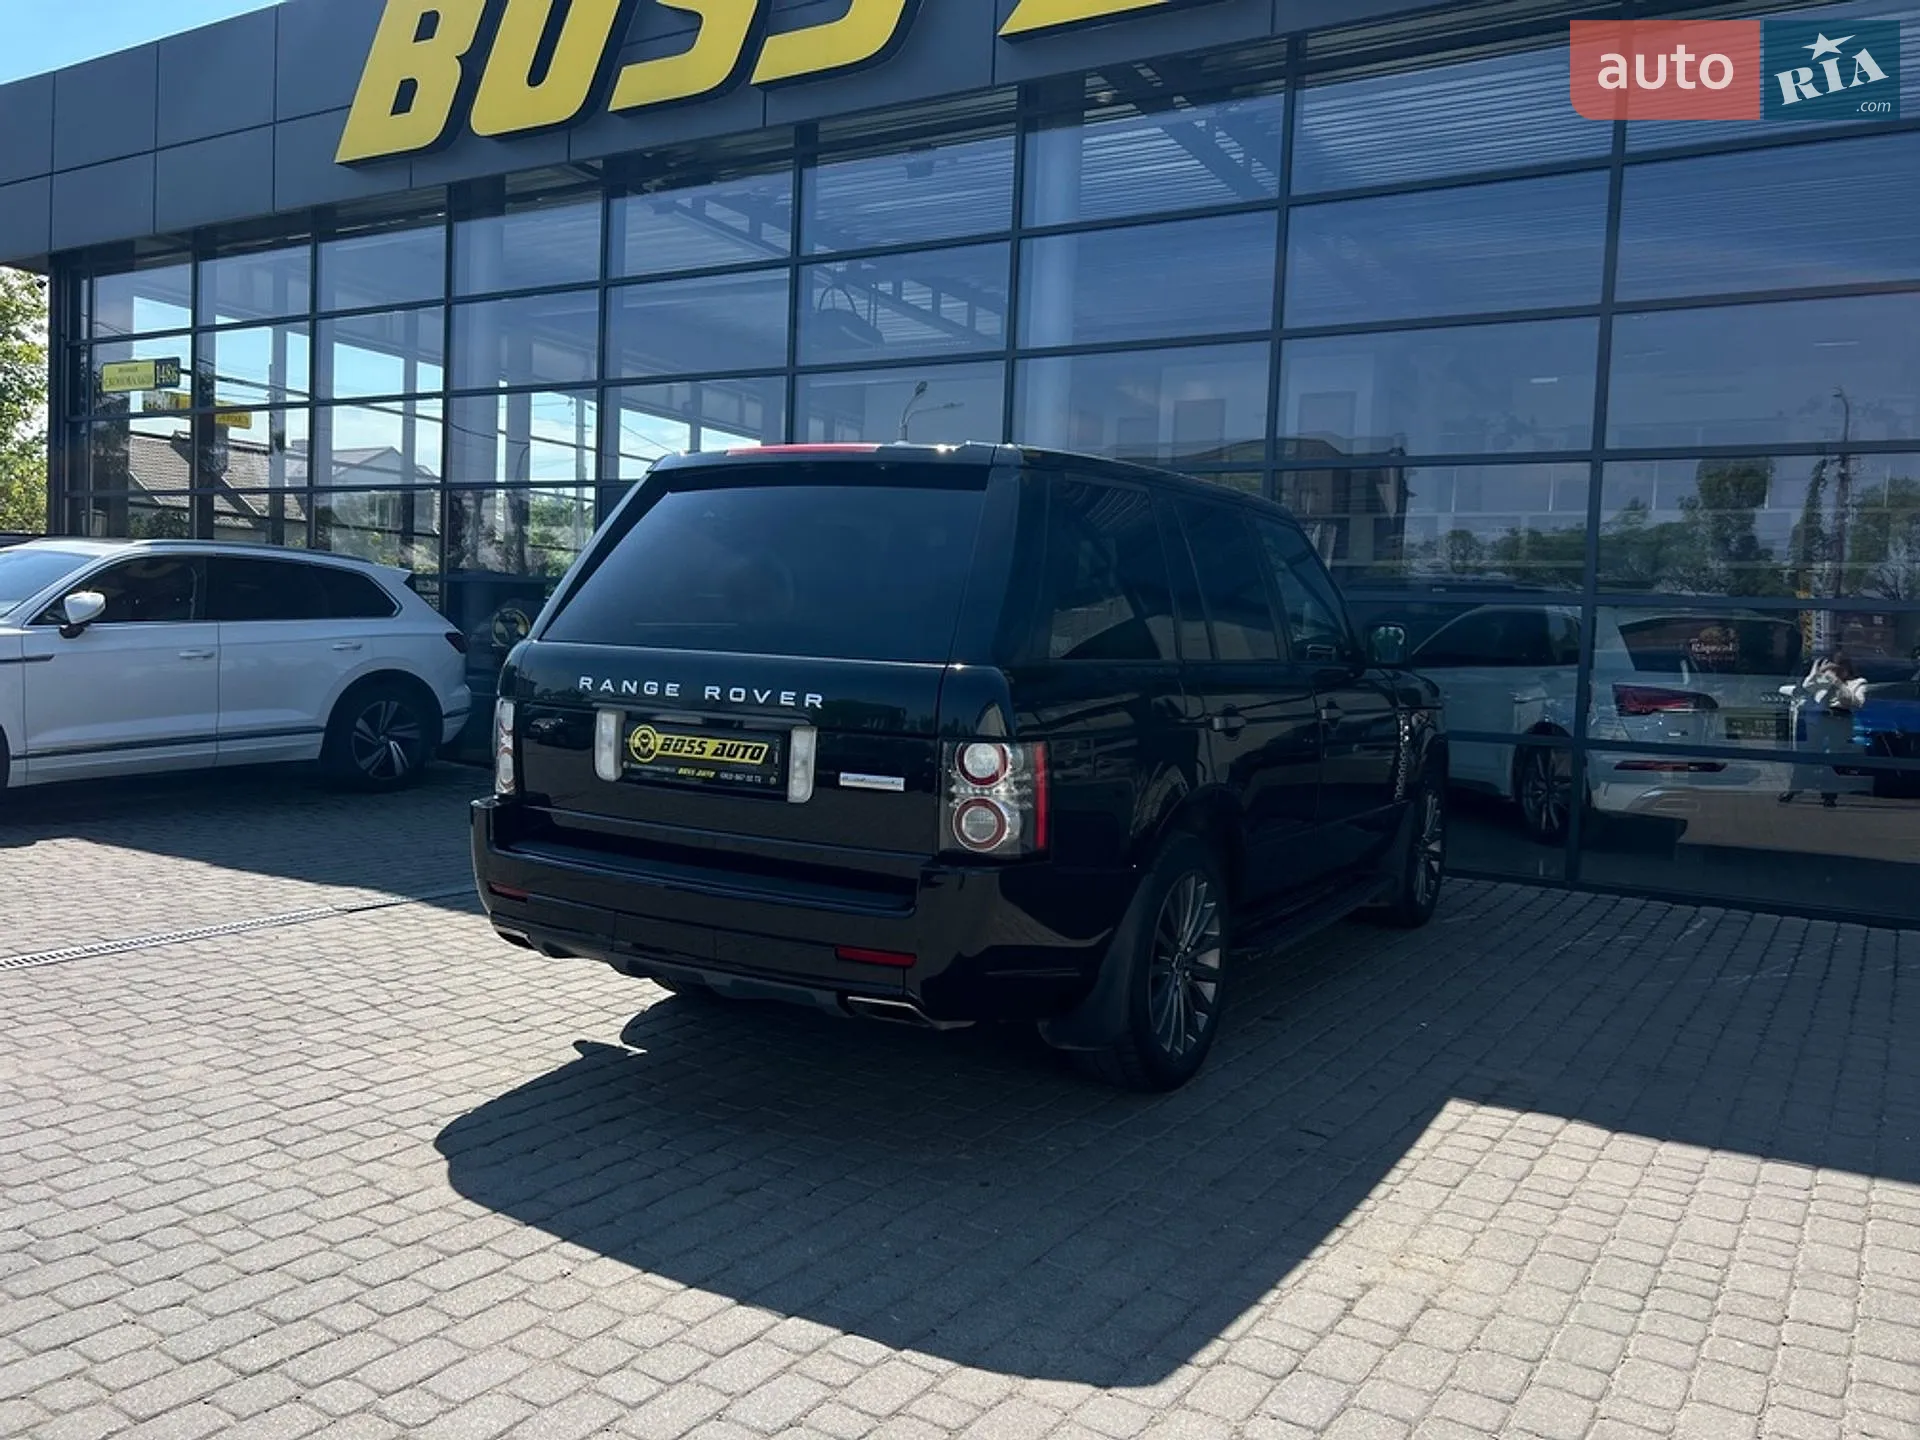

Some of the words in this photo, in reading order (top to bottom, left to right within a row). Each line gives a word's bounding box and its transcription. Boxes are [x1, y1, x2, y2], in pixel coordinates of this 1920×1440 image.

[578, 676, 680, 697] RANGE
[704, 685, 823, 708] ROVER
[660, 736, 708, 755] BOSS
[711, 742, 765, 761] AUTO
